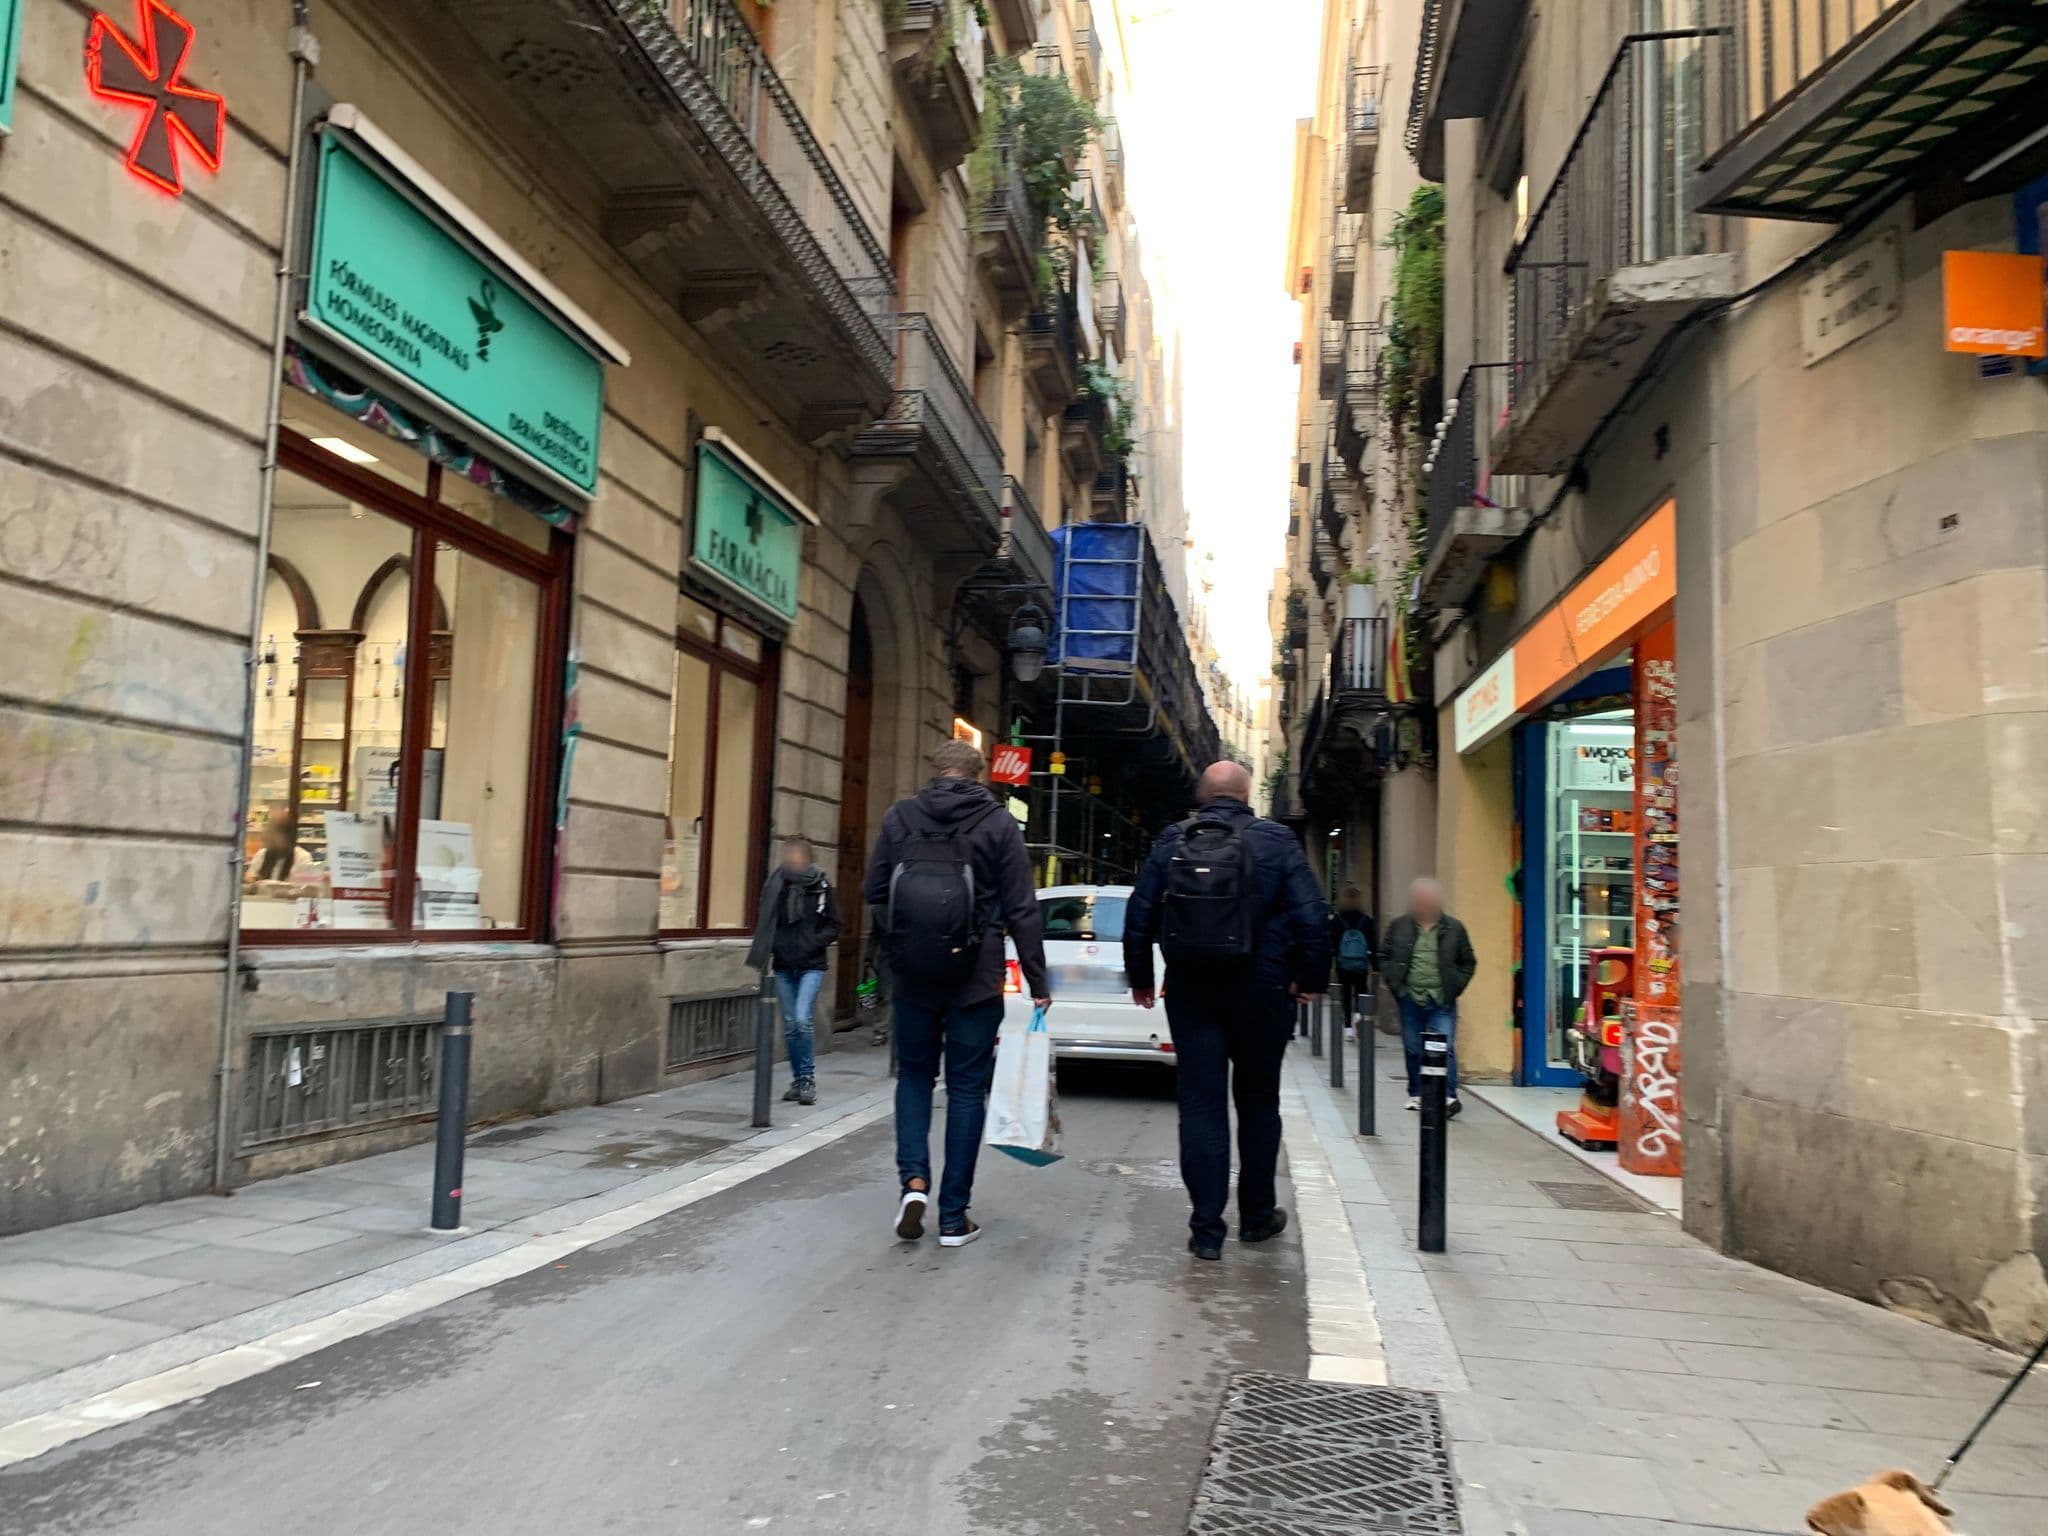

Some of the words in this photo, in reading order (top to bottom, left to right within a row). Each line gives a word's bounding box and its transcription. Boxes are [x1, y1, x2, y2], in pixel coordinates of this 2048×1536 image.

[327, 290, 422, 368] HOMEOPATIA
[1950, 327, 2037, 351] orange
[992, 750, 1028, 780] illy
